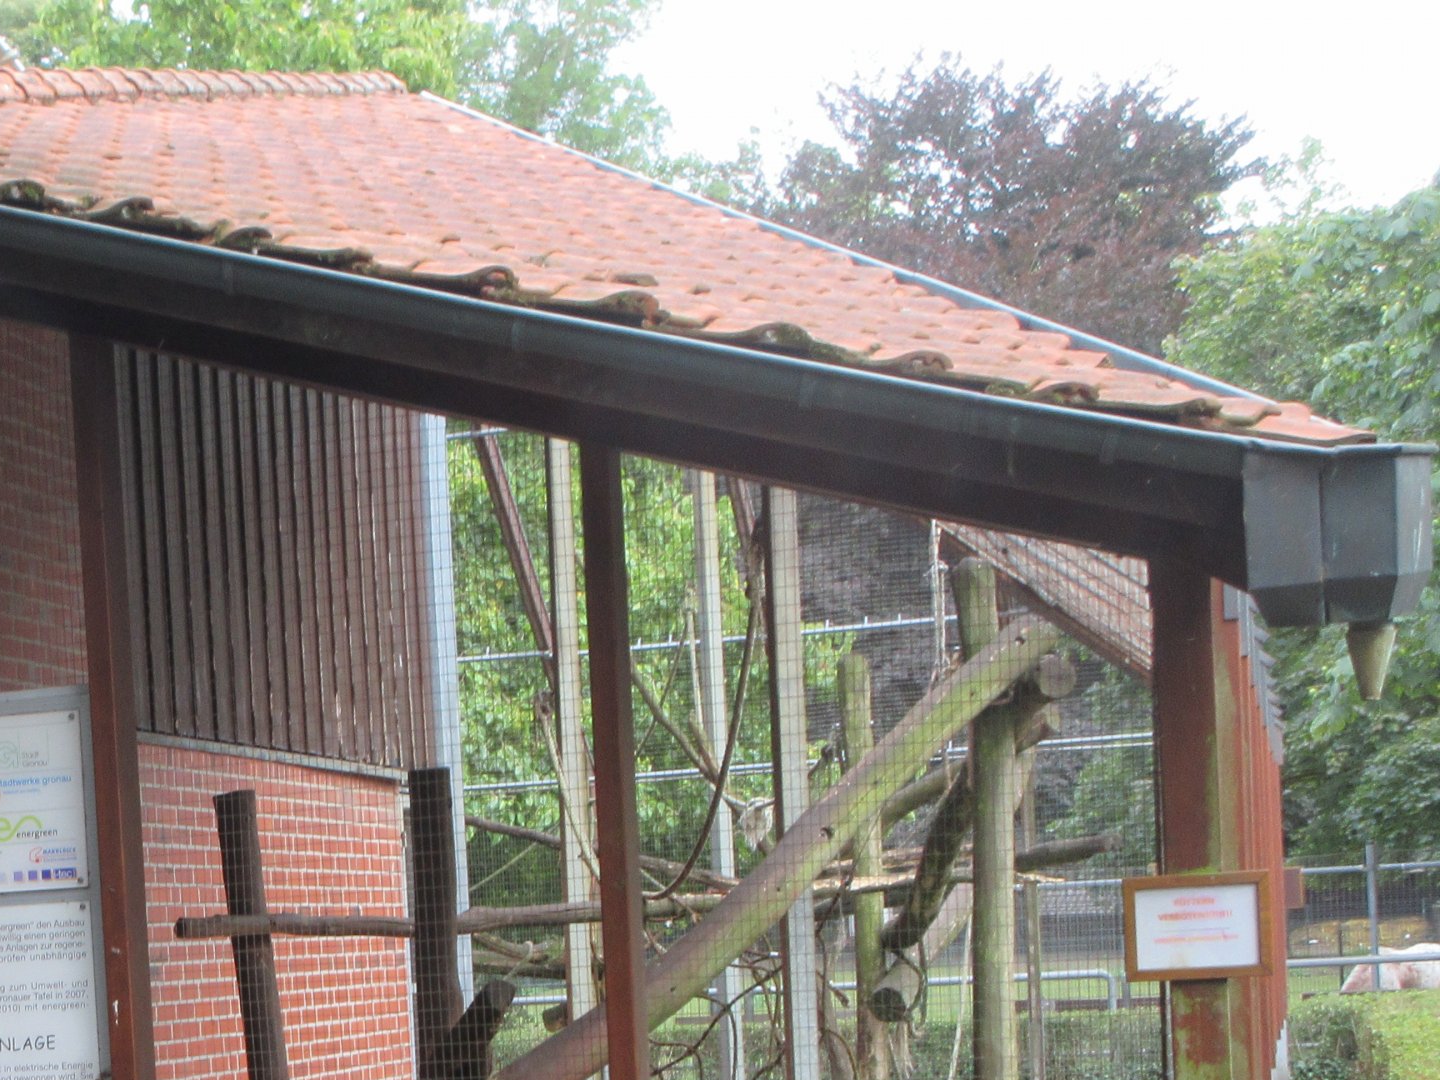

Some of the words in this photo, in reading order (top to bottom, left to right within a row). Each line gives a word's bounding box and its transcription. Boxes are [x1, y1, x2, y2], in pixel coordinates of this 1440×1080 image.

[42, 775, 72, 785] gronau
[16, 829, 58, 840] energreen
[36, 920, 51, 928] den
[53, 918, 84, 927] Ausbau
[23, 931, 46, 939] einen
[48, 928, 85, 939] geringen
[5, 942, 38, 953] Anlagen
[29, 950, 86, 962] unabhängige
[71, 979, 88, 987] und
[34, 991, 53, 1000] Tafel
[23, 1002, 38, 1010] mit
[3, 1064, 11, 1072] in
[13, 1061, 58, 1071] elektrische
[61, 1060, 93, 1071] Energie
[79, 1070, 93, 1078] Sie
